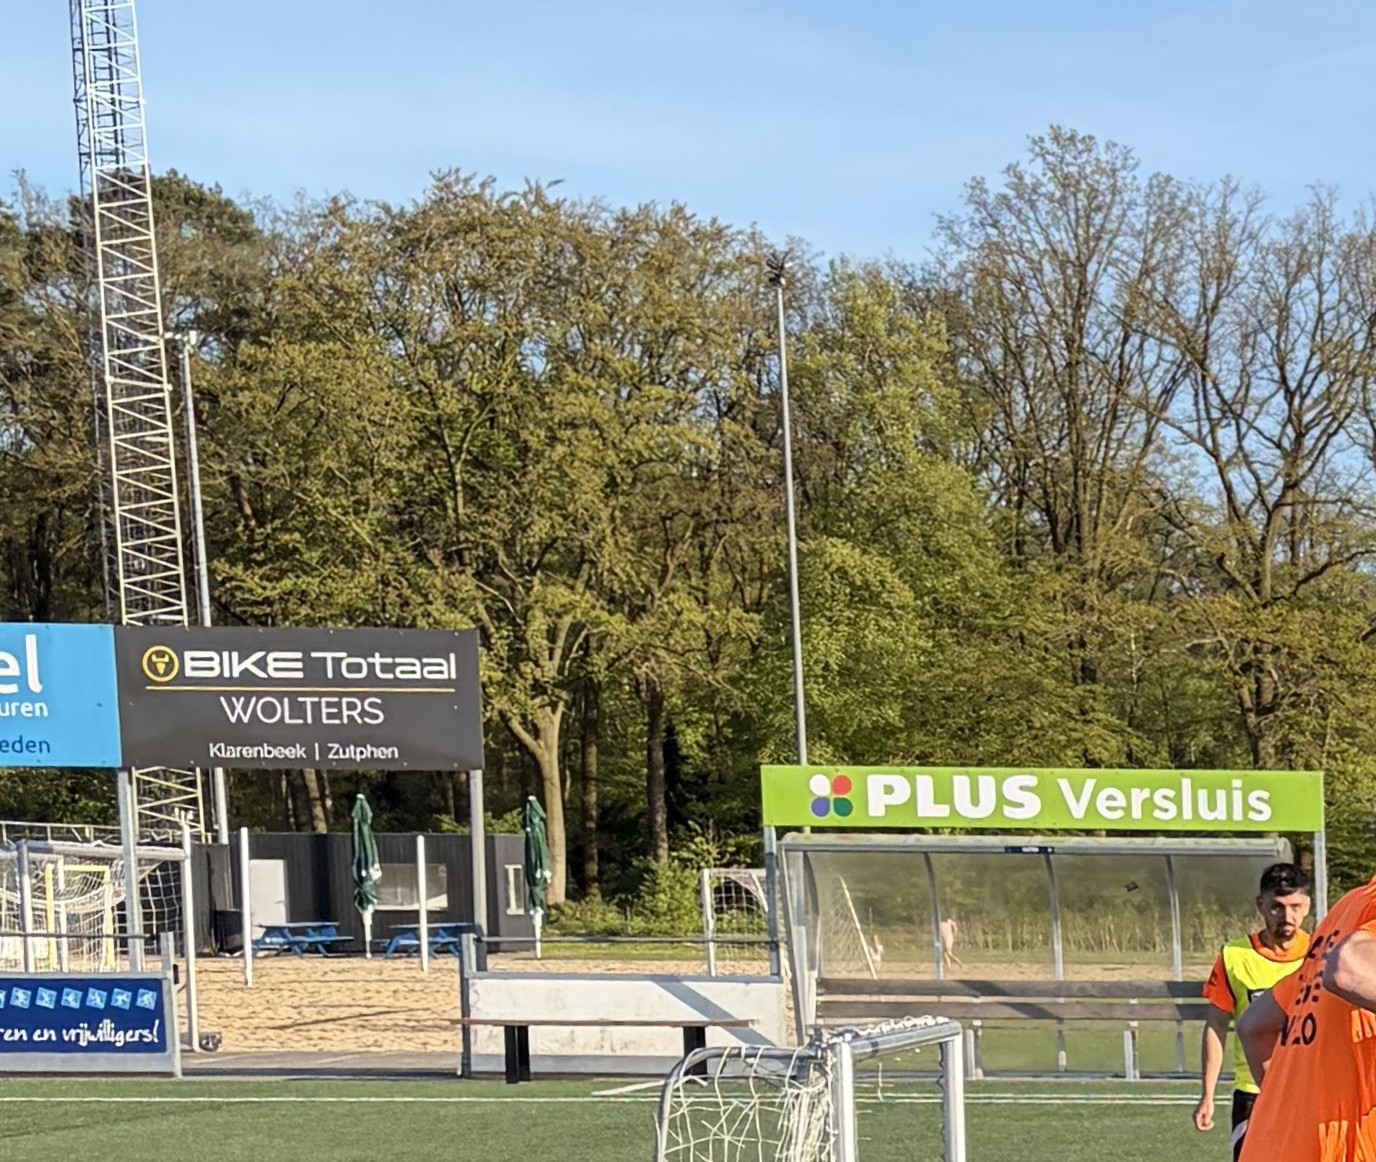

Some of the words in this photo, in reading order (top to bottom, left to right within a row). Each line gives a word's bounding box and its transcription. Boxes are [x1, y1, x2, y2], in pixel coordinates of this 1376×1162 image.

[183, 650, 304, 679] BIKE
[310, 652, 457, 680] Totaal
[219, 696, 385, 725] WOLTERS
[208, 742, 307, 759] Klarenbeek
[326, 742, 399, 762] Zutphen
[867, 774, 1042, 819] PLUS
[1057, 777, 1274, 823] Versluis
[32, 1027, 57, 1042] en
[62, 1019, 160, 1047] vrijwilligers!
